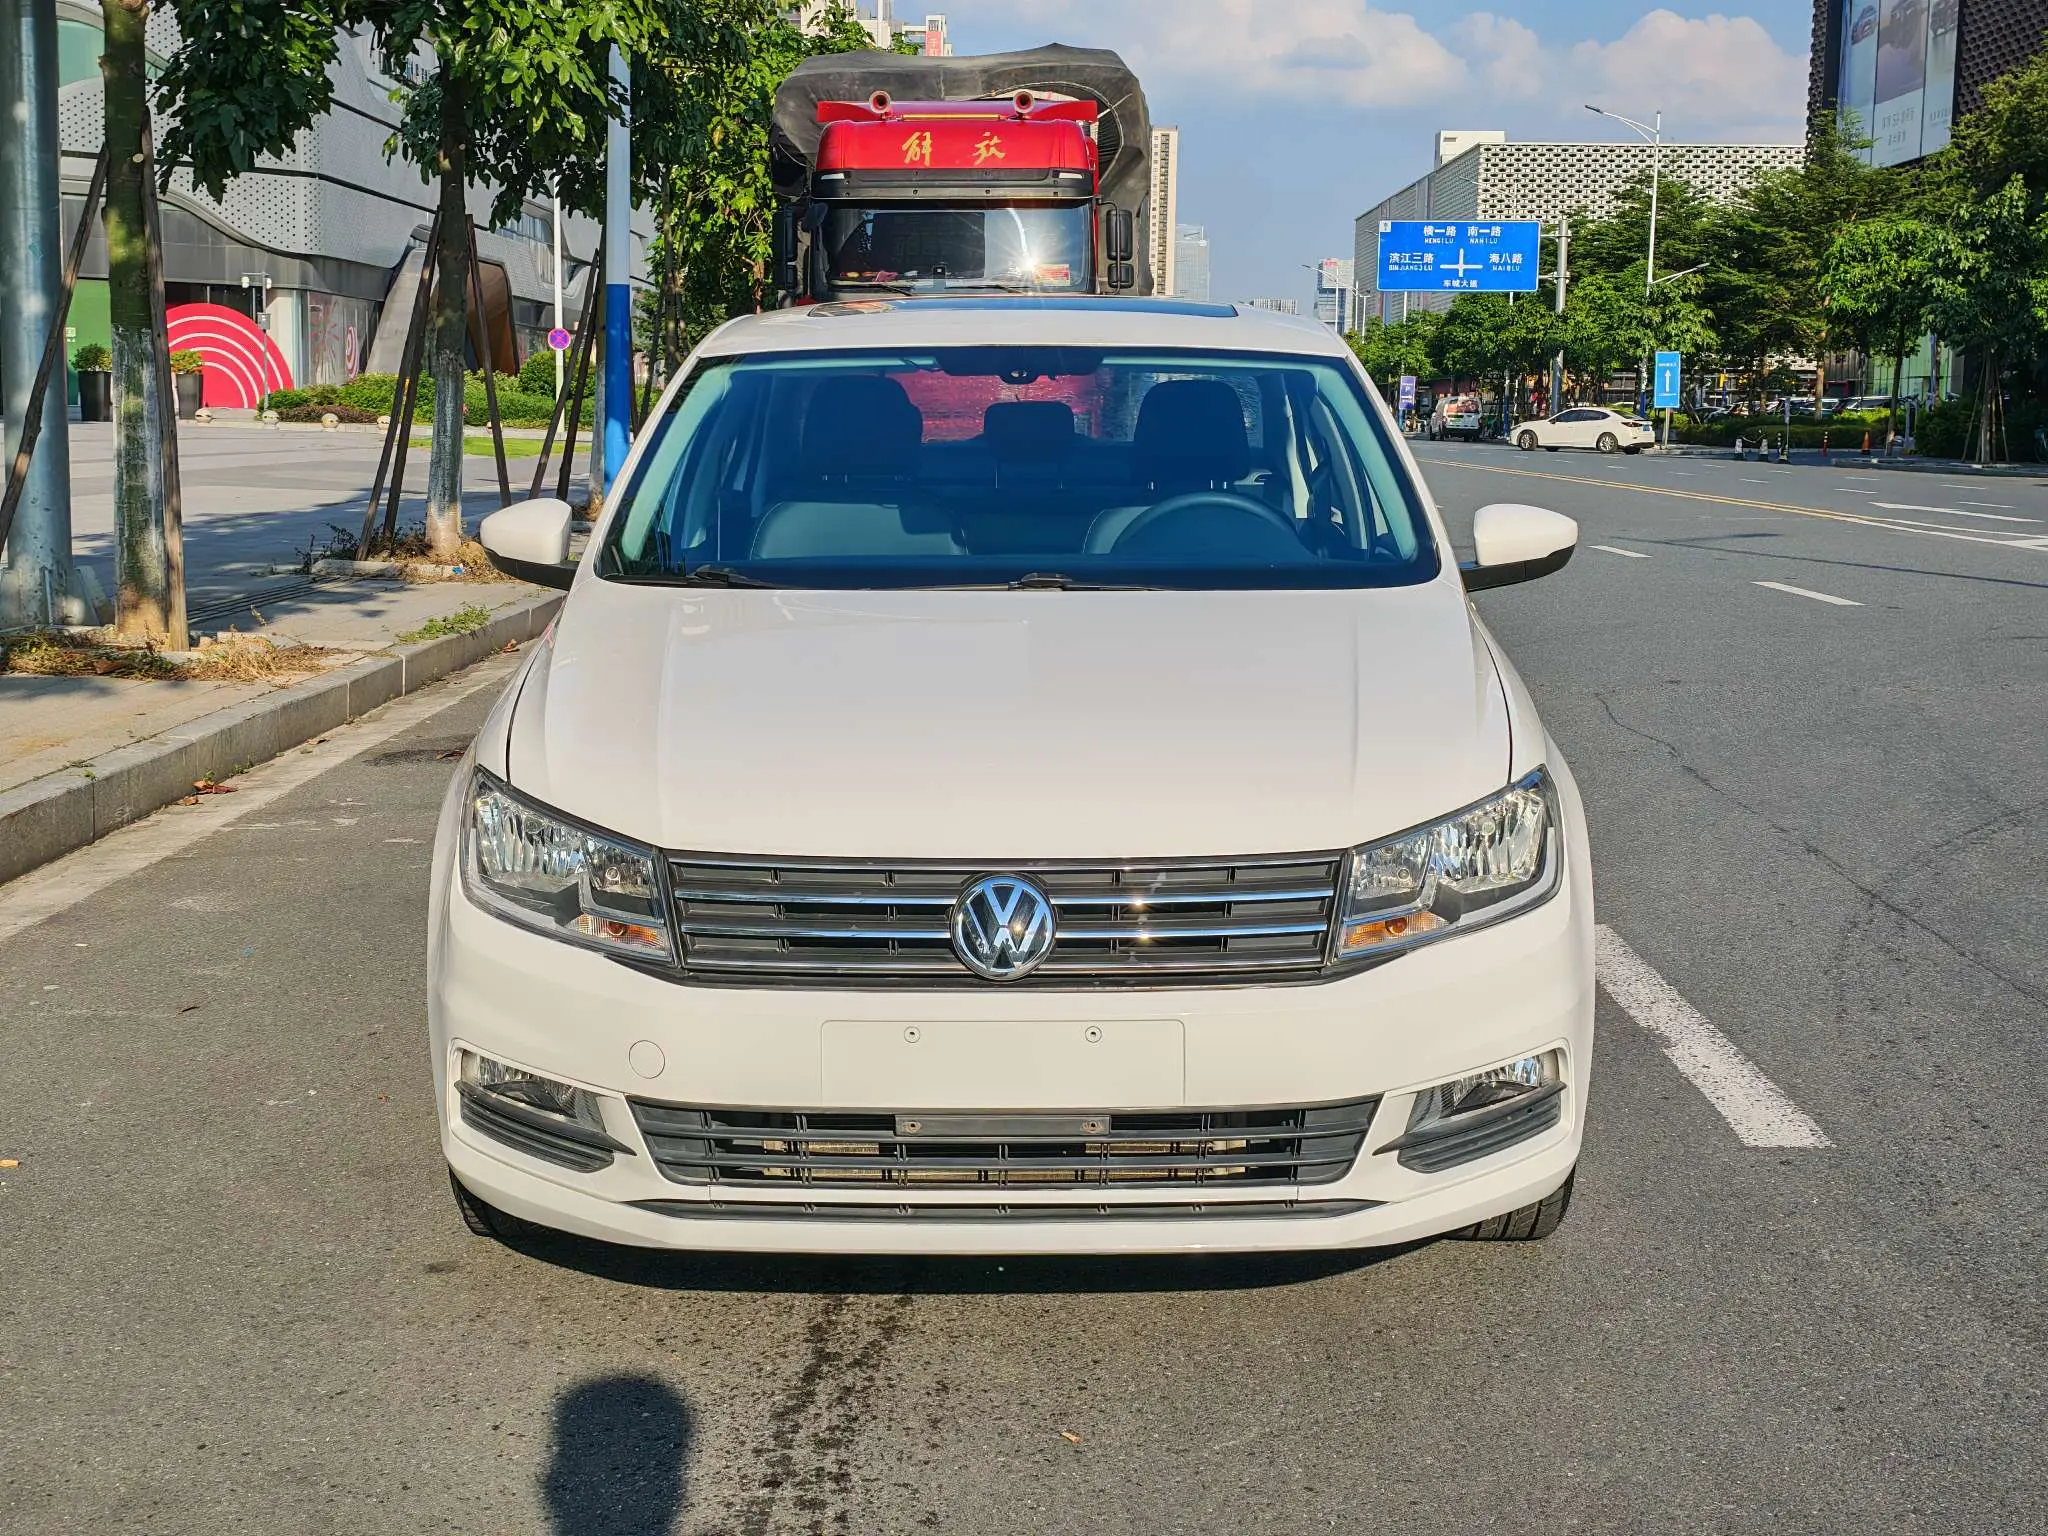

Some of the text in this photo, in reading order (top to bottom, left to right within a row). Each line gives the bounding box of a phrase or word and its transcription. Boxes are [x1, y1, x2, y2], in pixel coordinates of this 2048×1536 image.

[1423, 225, 1502, 237] 横一路 南一路
[1389, 252, 1523, 264] 滨江三路 海八路
